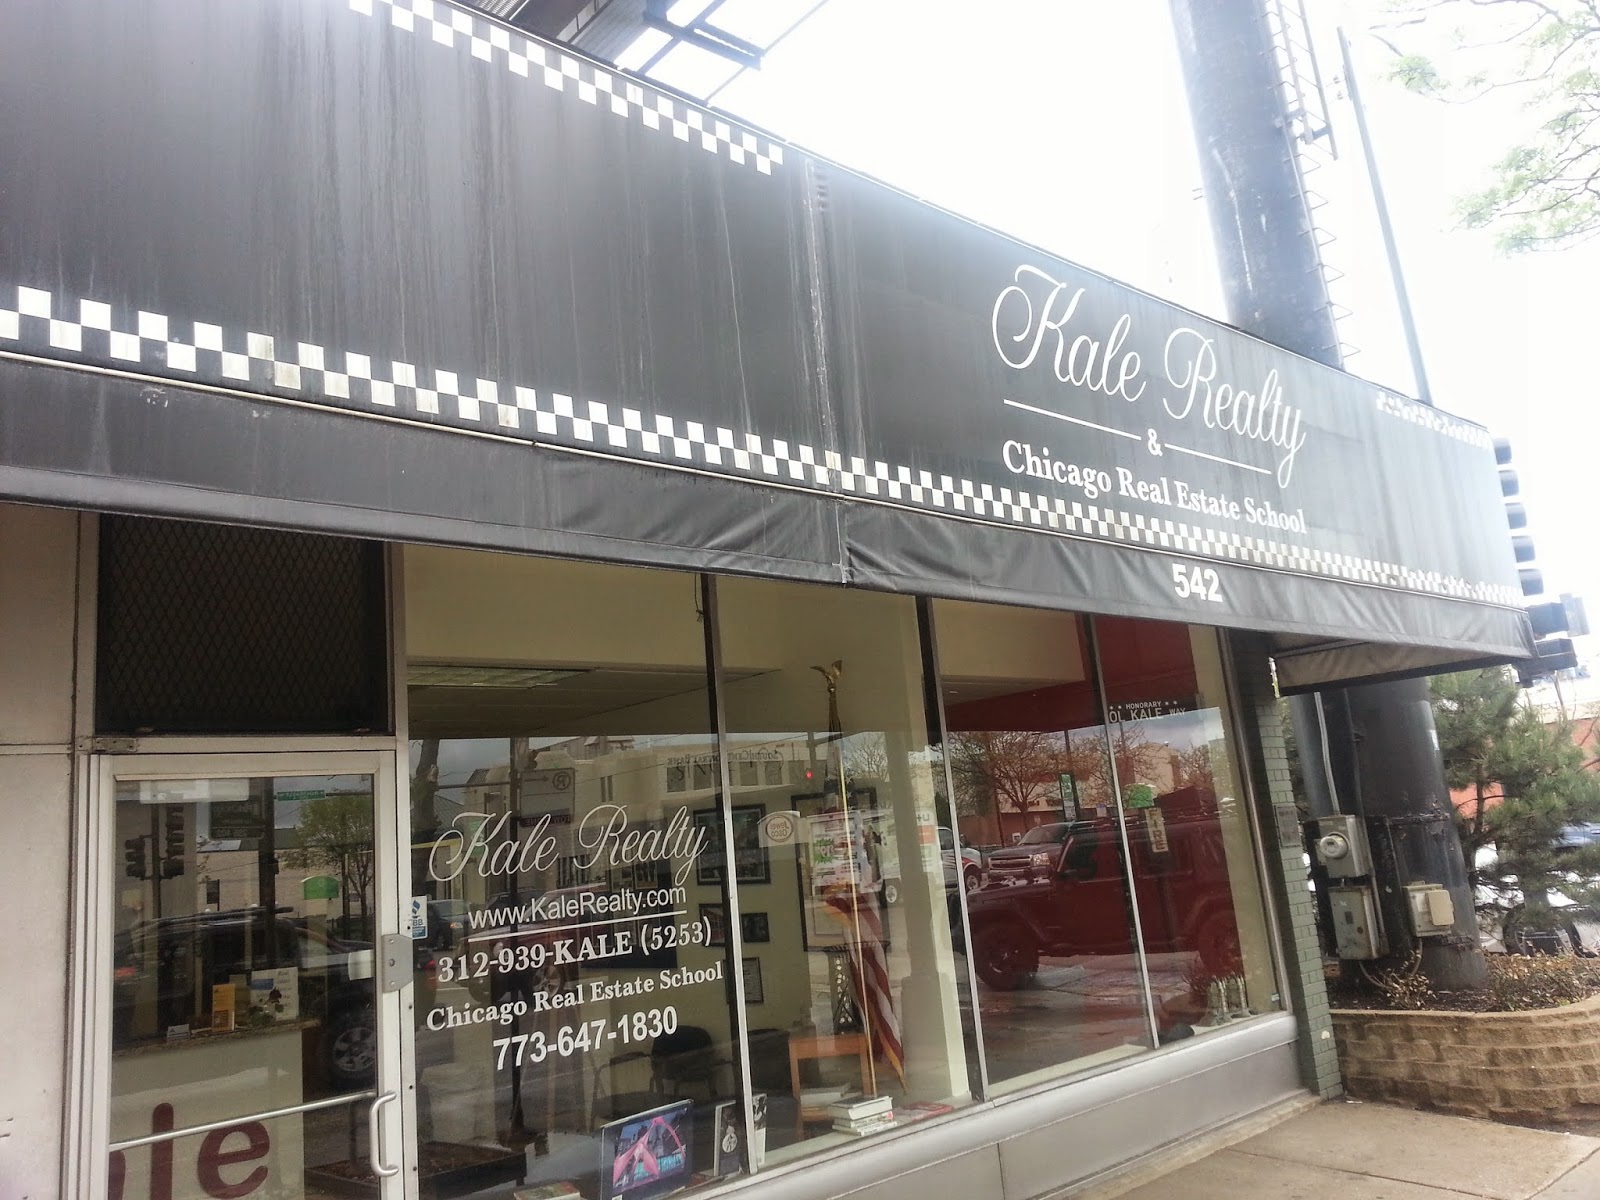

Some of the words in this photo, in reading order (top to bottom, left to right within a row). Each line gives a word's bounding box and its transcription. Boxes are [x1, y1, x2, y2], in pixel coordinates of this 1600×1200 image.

[992, 264, 1147, 402] Kale
[1163, 327, 1307, 489] Realty
[1147, 428, 1164, 457] &
[1002, 439, 1112, 499] Chicago
[1116, 466, 1172, 507] Real
[1174, 480, 1241, 522] Estate
[1243, 496, 1308, 535] School
[1171, 562, 1224, 604] 542
[1125, 700, 1162, 710] HONORARY
[1130, 708, 1164, 721] KALE
[1168, 707, 1187, 717] WAY
[428, 810, 560, 882] Kale
[573, 804, 710, 886] Realty
[468, 885, 687, 930] www.KaleRealty.com
[437, 930, 633, 984] 312-939-KALE
[641, 916, 712, 956] (5253)
[426, 1000, 527, 1032] Chicago
[533, 984, 585, 1013] Real
[590, 974, 654, 1003] Estate
[659, 961, 724, 991] School
[493, 1005, 678, 1071] 773-647-1830
